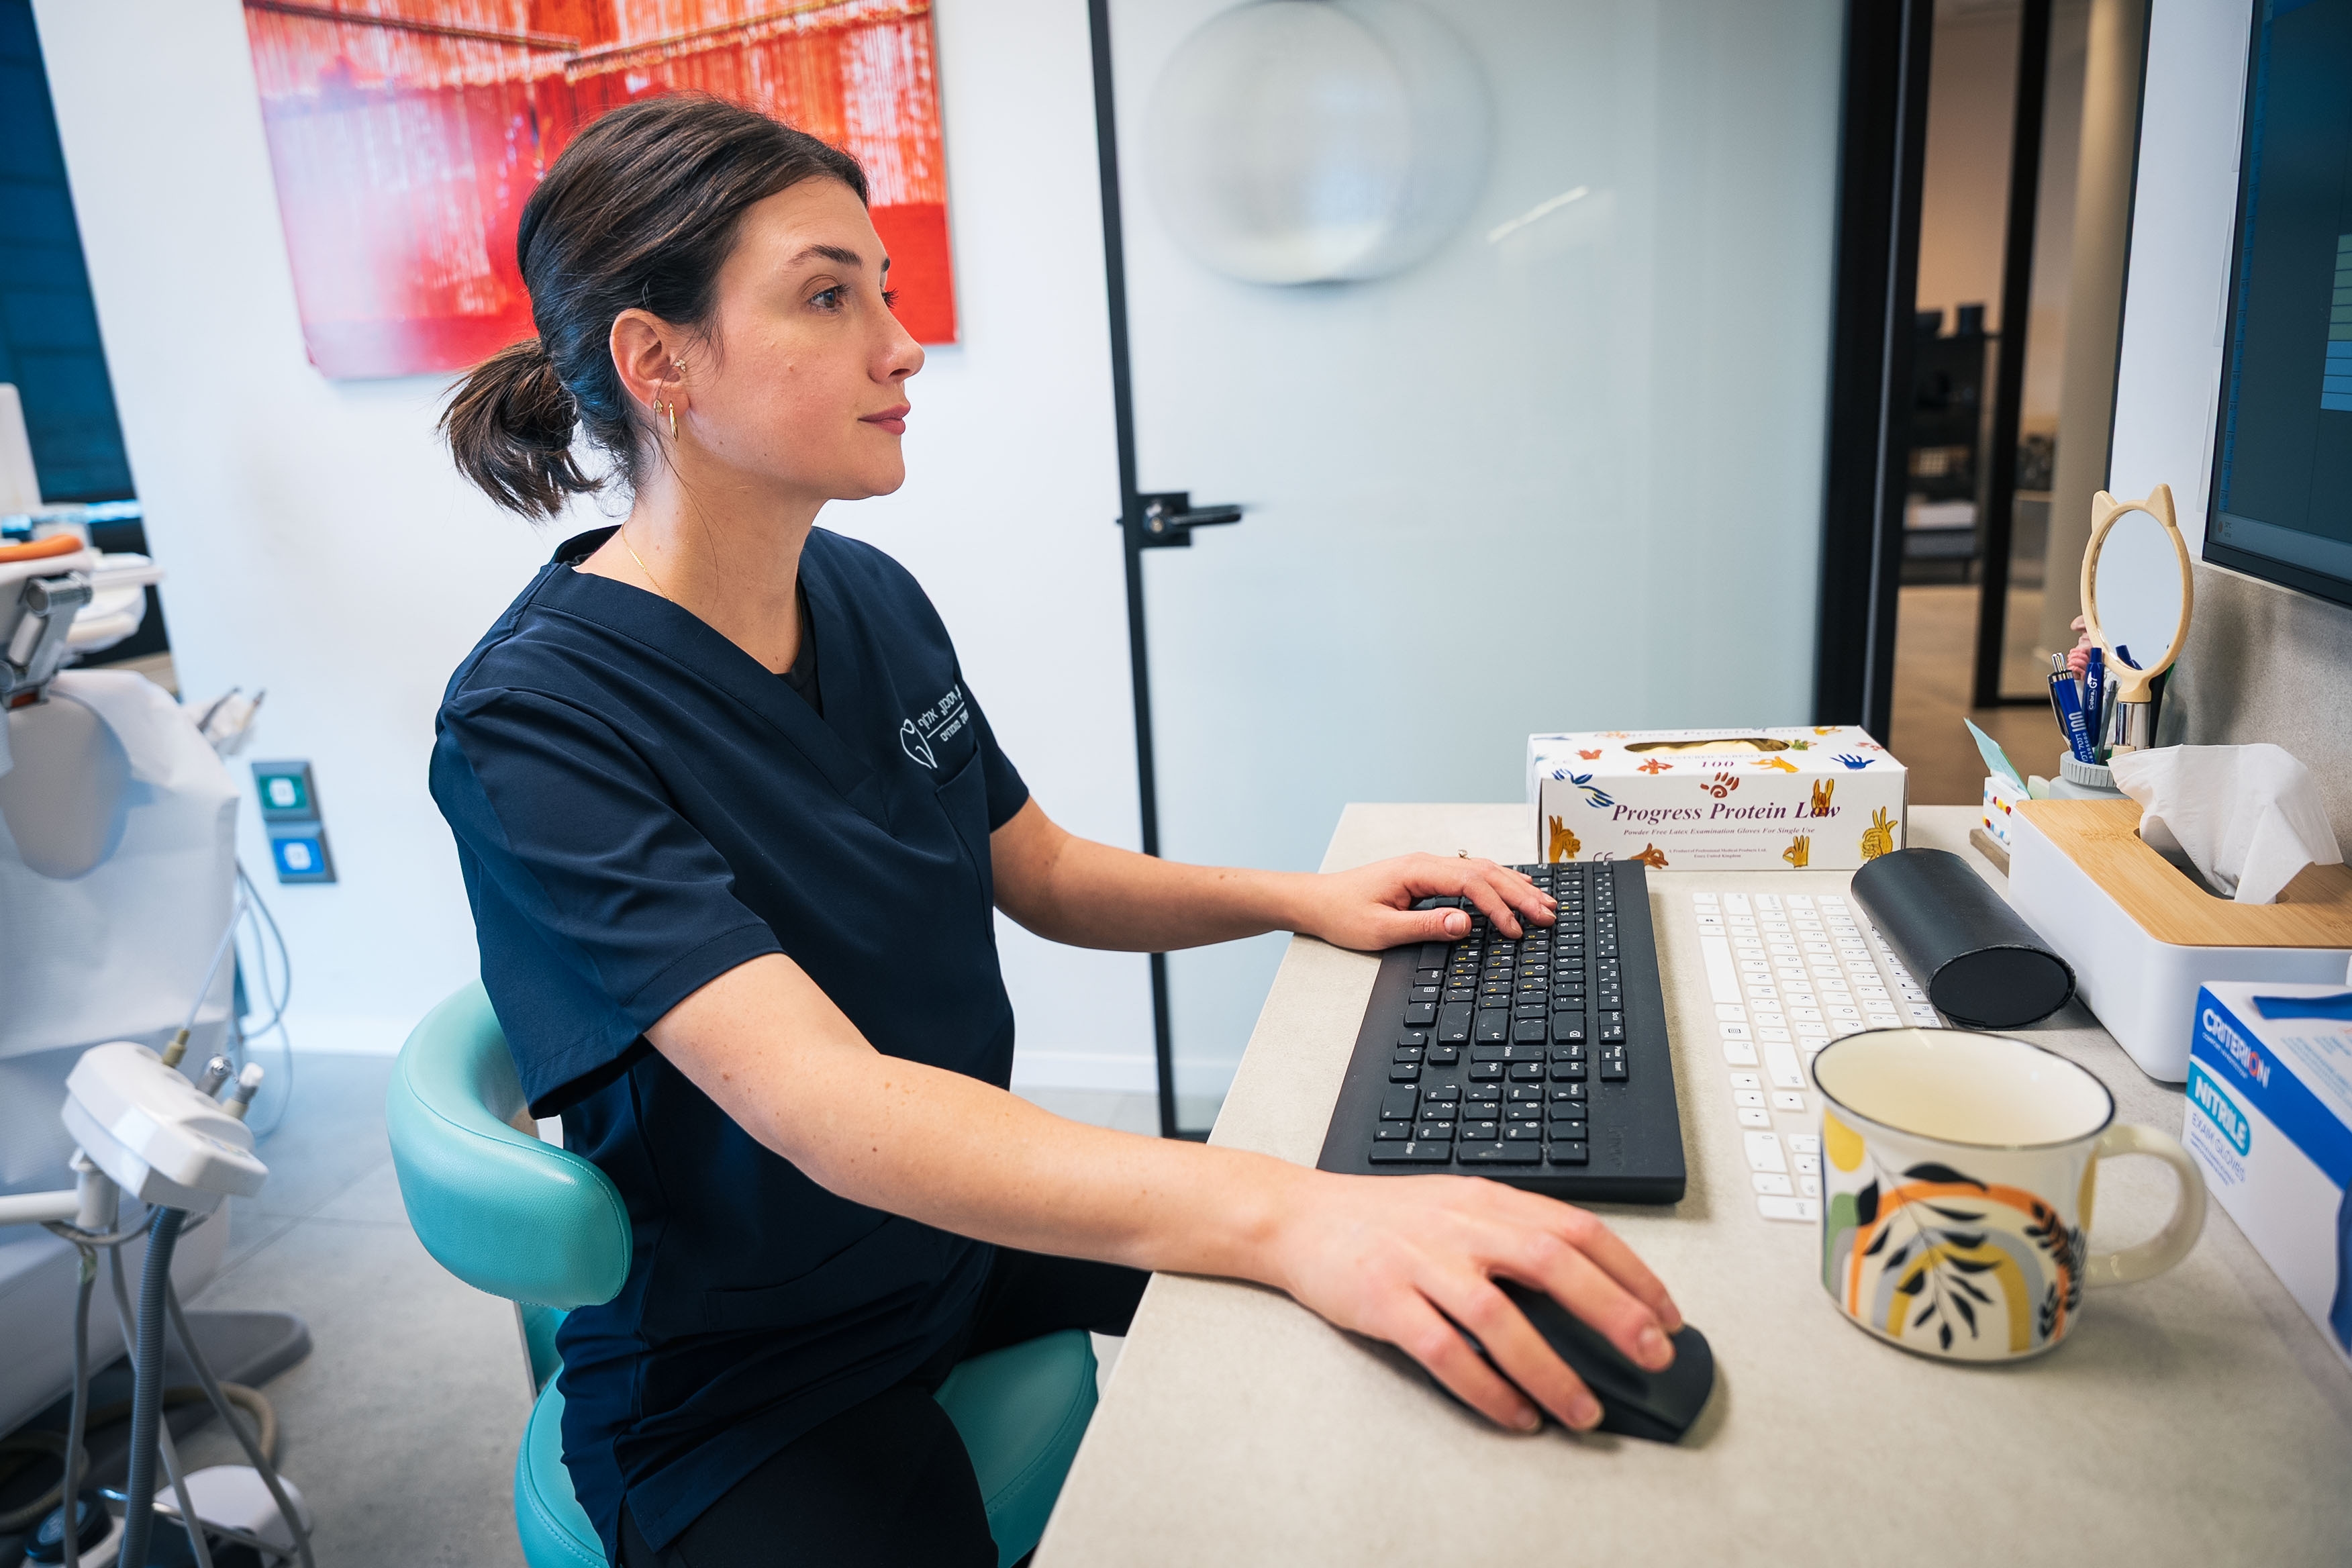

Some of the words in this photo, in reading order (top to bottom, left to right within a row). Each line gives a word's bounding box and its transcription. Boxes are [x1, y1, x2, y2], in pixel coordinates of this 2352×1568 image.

[1612, 805, 1702, 825] Progress
[1709, 802, 1786, 820] Protein
[1794, 801, 1840, 818] Low
[1778, 827, 1800, 835] Single
[2202, 1008, 2270, 1089] CRITERION
[2191, 1112, 2214, 1142] EXAM
[2215, 1138, 2245, 1182] GLOVES
[2194, 1075, 2248, 1149] NITRILE
